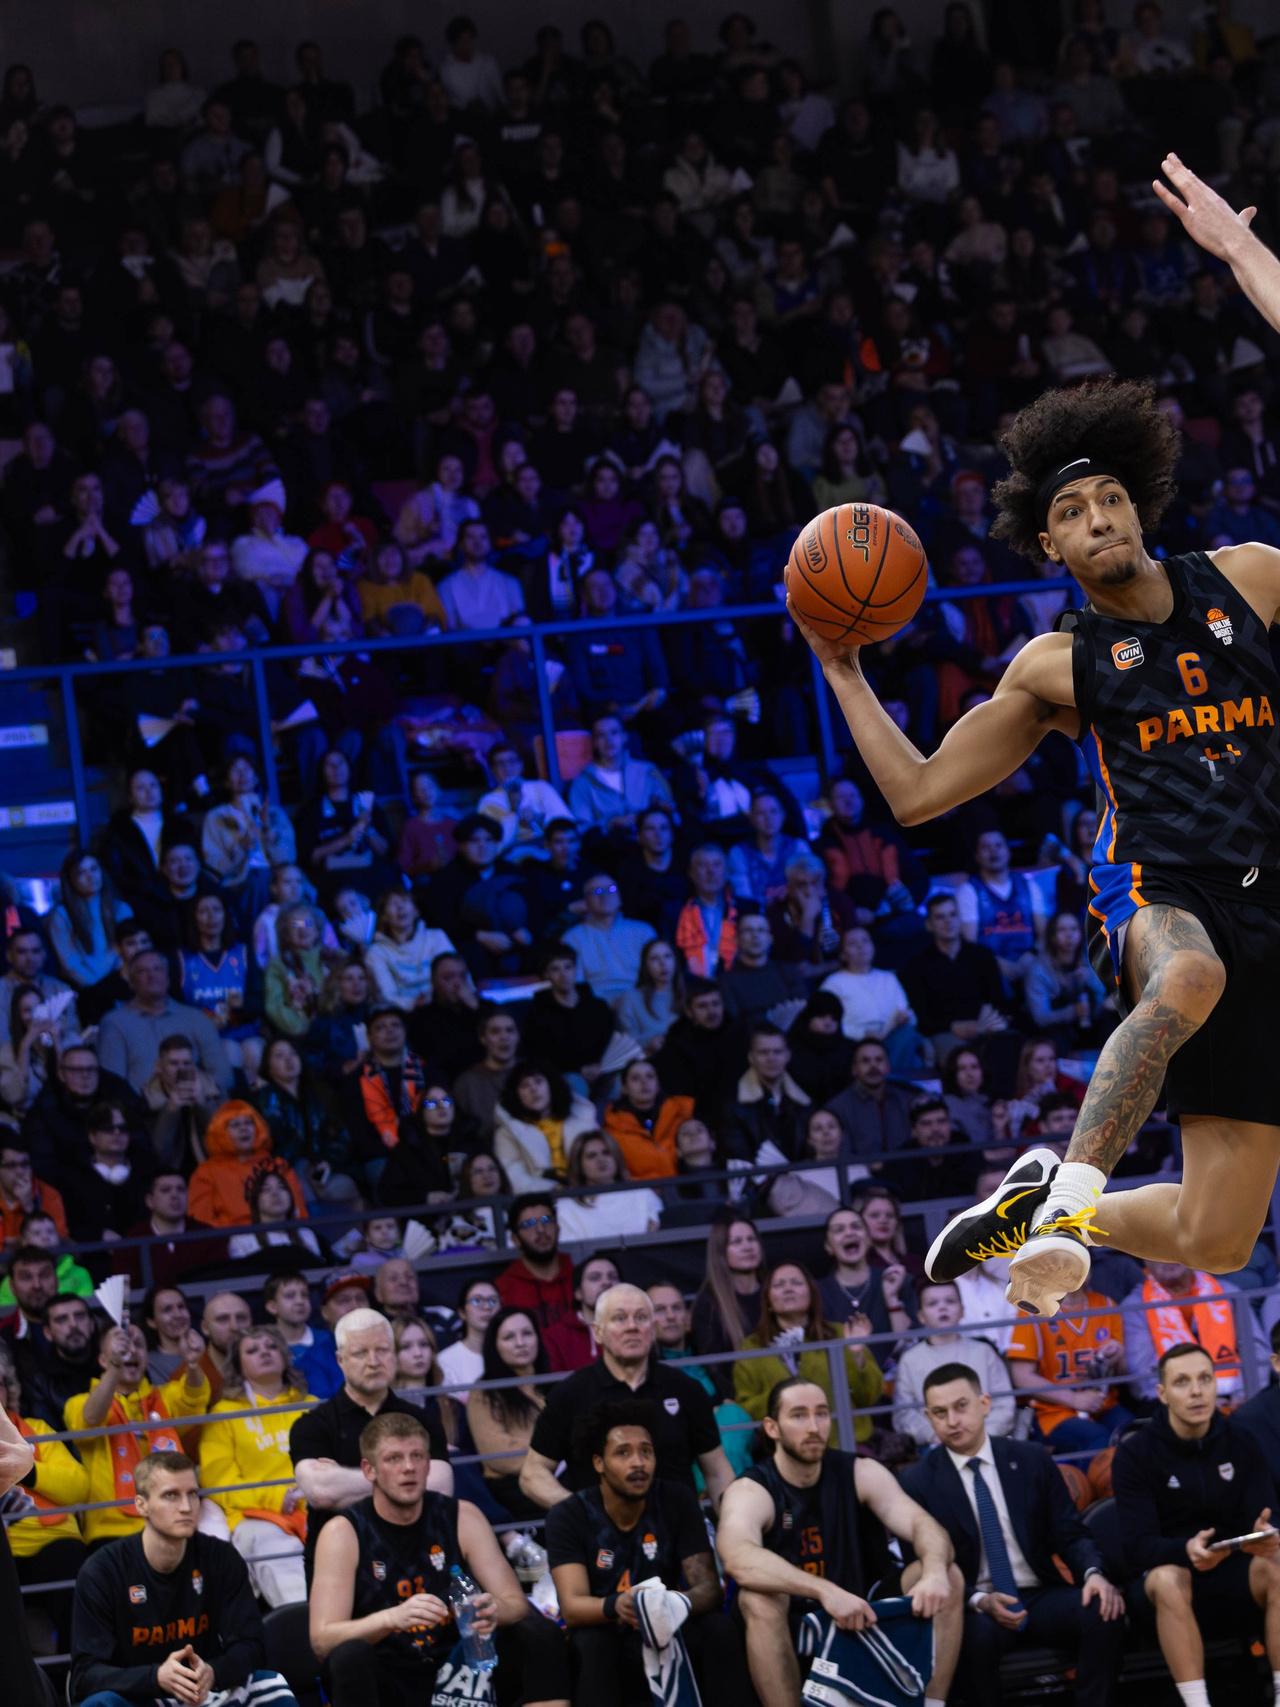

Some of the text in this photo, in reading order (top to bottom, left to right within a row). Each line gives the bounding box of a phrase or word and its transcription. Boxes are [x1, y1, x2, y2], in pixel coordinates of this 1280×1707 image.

[1119, 646, 1141, 661] WIN
[1221, 635, 1233, 646] CUP
[1176, 652, 1209, 697] 6
[1135, 695, 1276, 753] PARMA
[132, 1613, 210, 1647] PARMA
